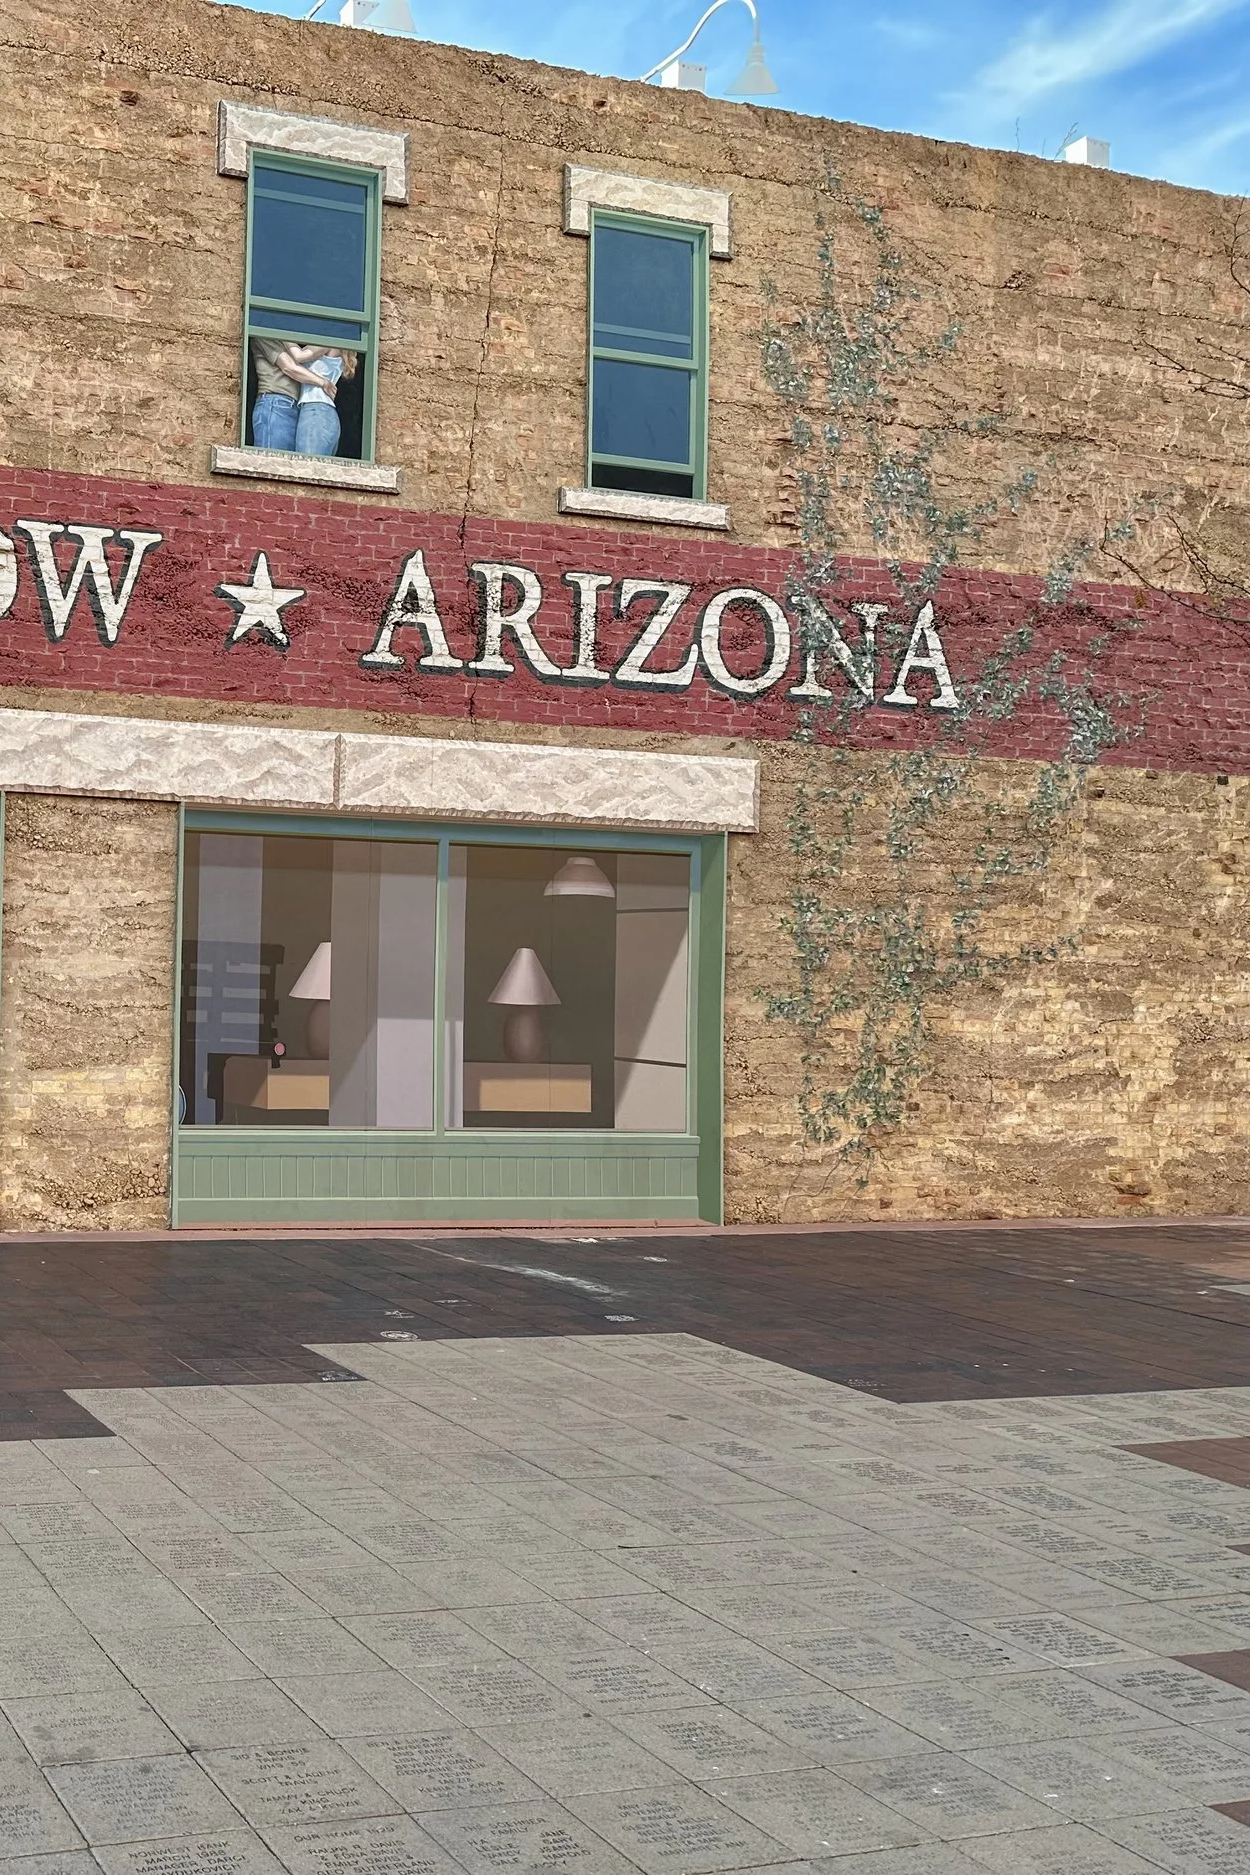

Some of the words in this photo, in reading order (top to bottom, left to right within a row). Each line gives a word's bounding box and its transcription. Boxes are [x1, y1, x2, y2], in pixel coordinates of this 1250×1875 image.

[360, 548, 958, 711] ARIZONA
[489, 1827, 531, 1835] FAMILY
[369, 1840, 406, 1848] DAVIS
[126, 1846, 192, 1858] NORWEST
[195, 1842, 232, 1850] BANK
[371, 1847, 407, 1855] DAVIS
[542, 1850, 592, 1859] HAROLD
[143, 1854, 190, 1864] MARCH
[364, 1855, 401, 1863] DAVIS
[351, 1859, 436, 1872] SUTHERLAND
